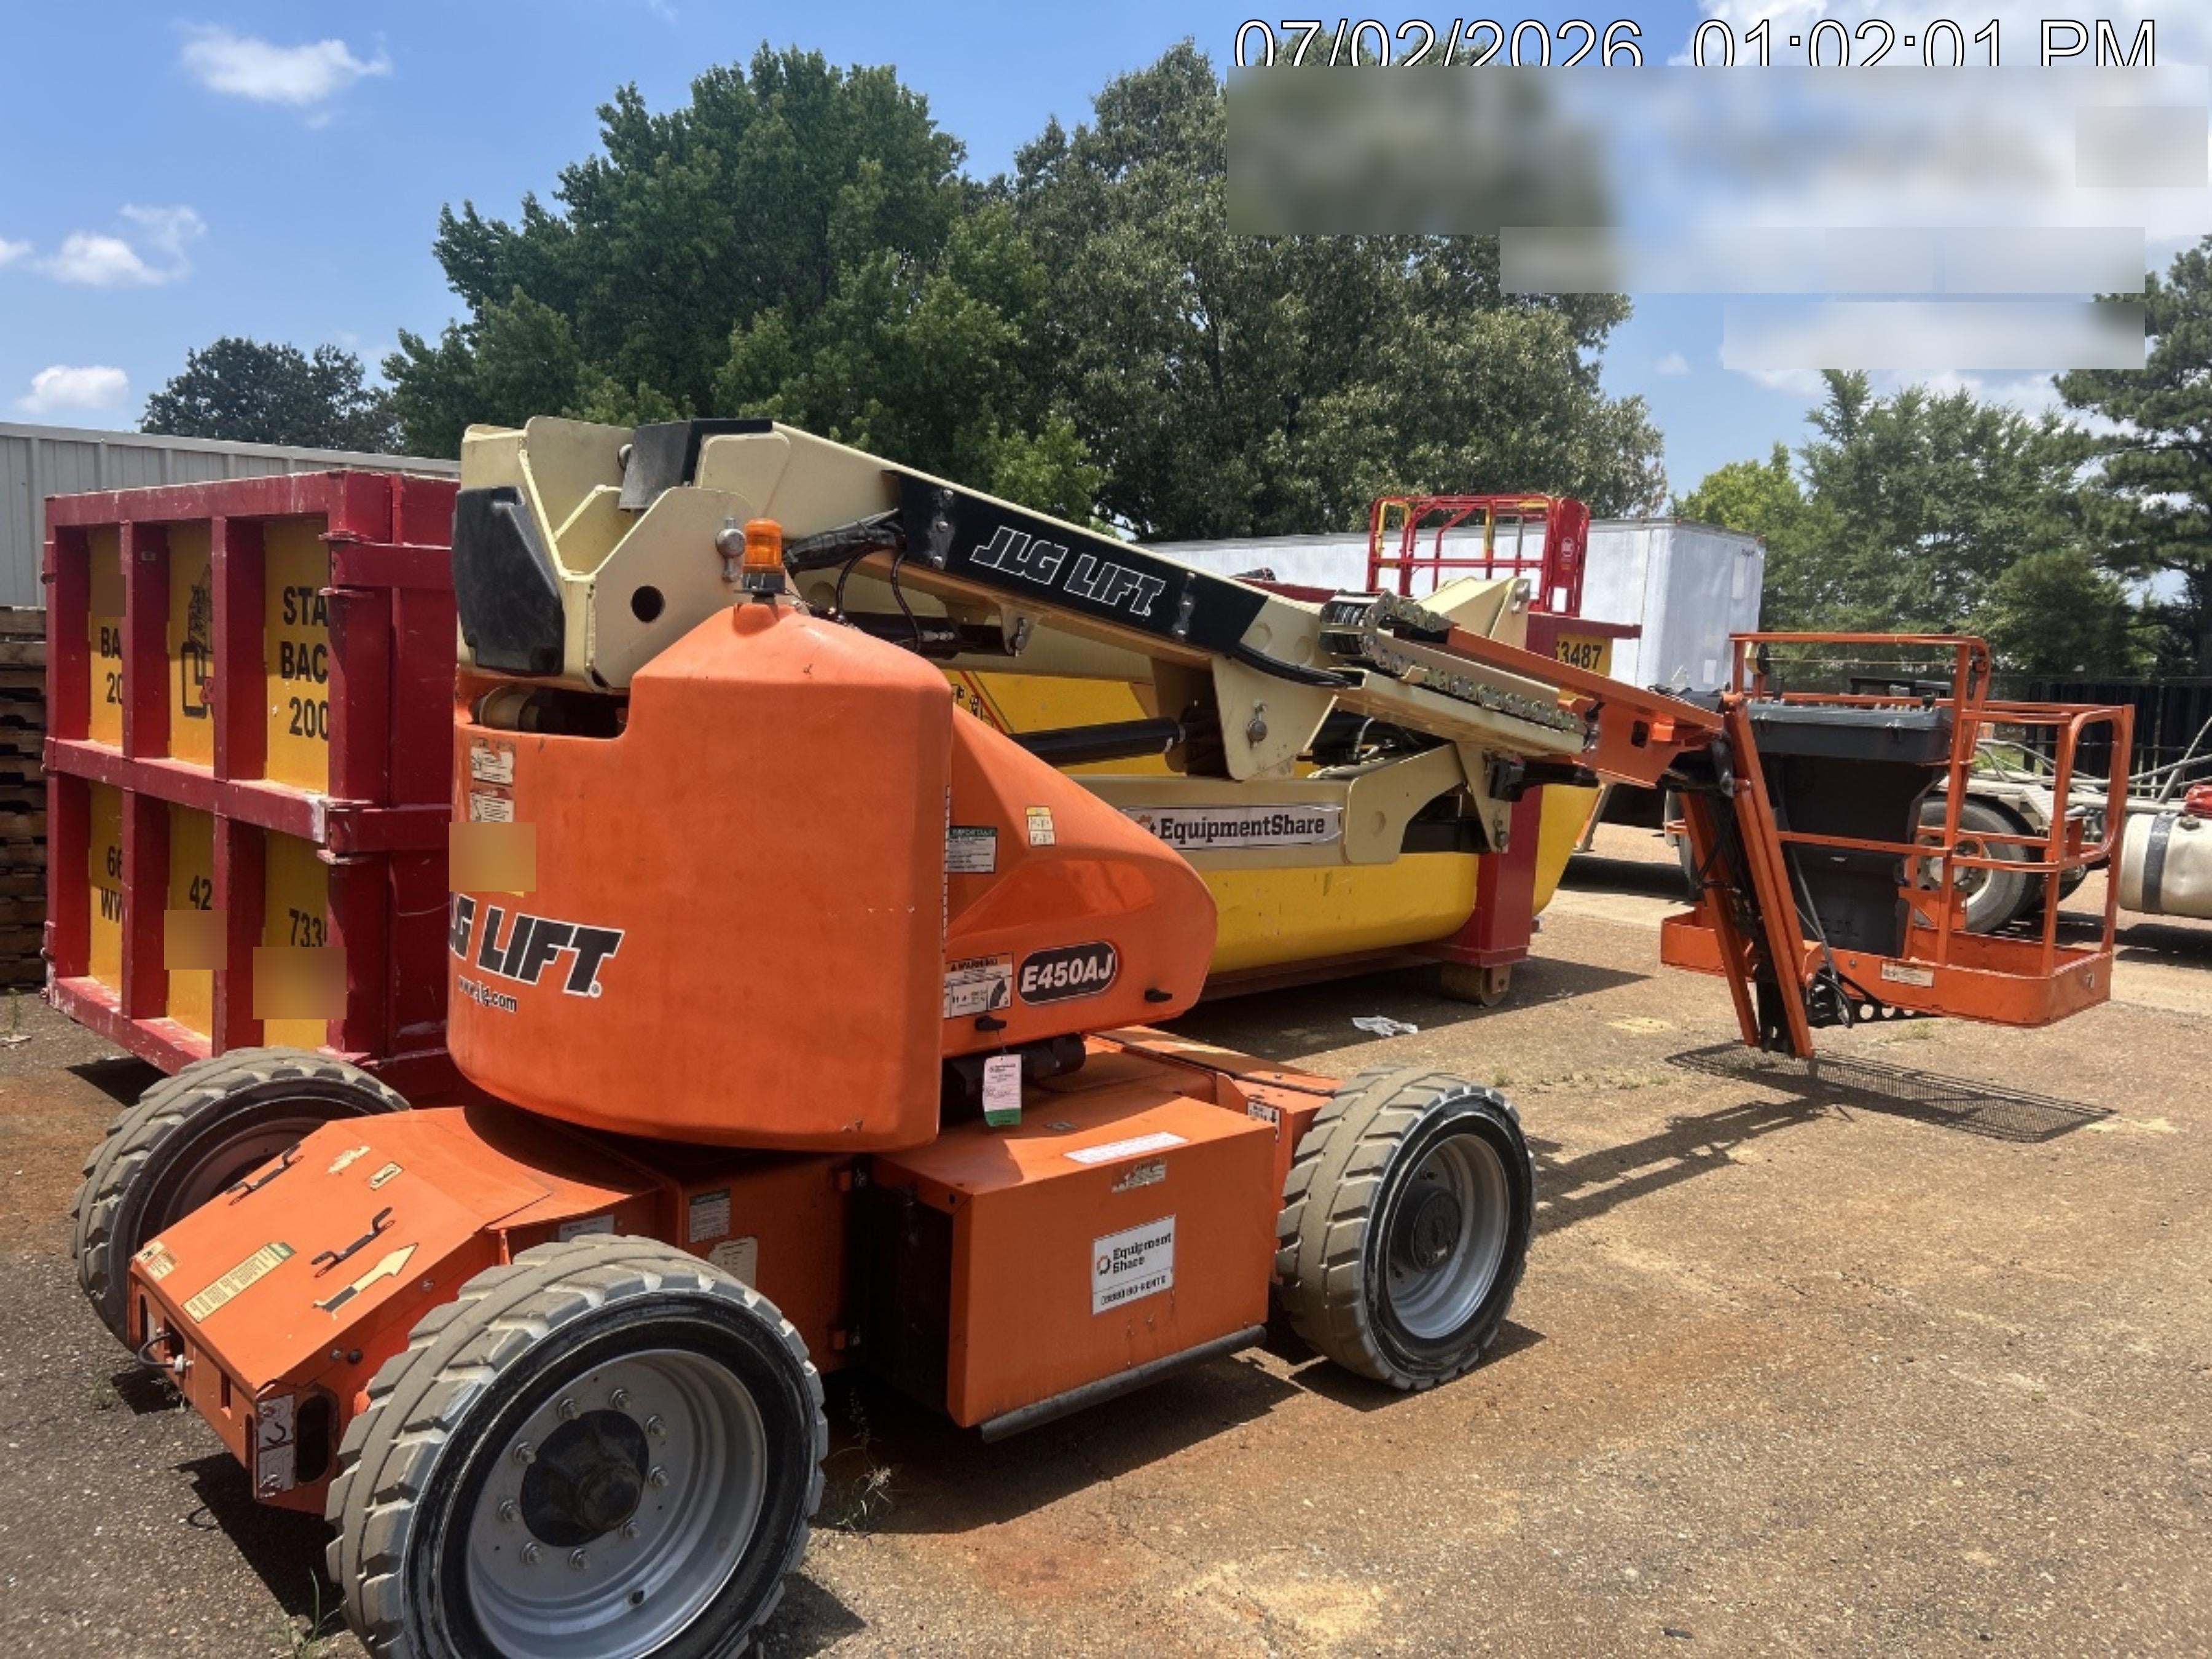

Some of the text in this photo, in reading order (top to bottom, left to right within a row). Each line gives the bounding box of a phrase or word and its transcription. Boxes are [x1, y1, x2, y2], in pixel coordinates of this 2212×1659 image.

[969, 525, 1166, 616] JLG LIFT
[1159, 814, 1325, 844] EquipmentShare
[476, 904, 626, 997] LIFT
[1021, 952, 1113, 993] E450AJ
[1113, 1232, 1172, 1260] Equipment
[1113, 1257, 1145, 1274] Share
